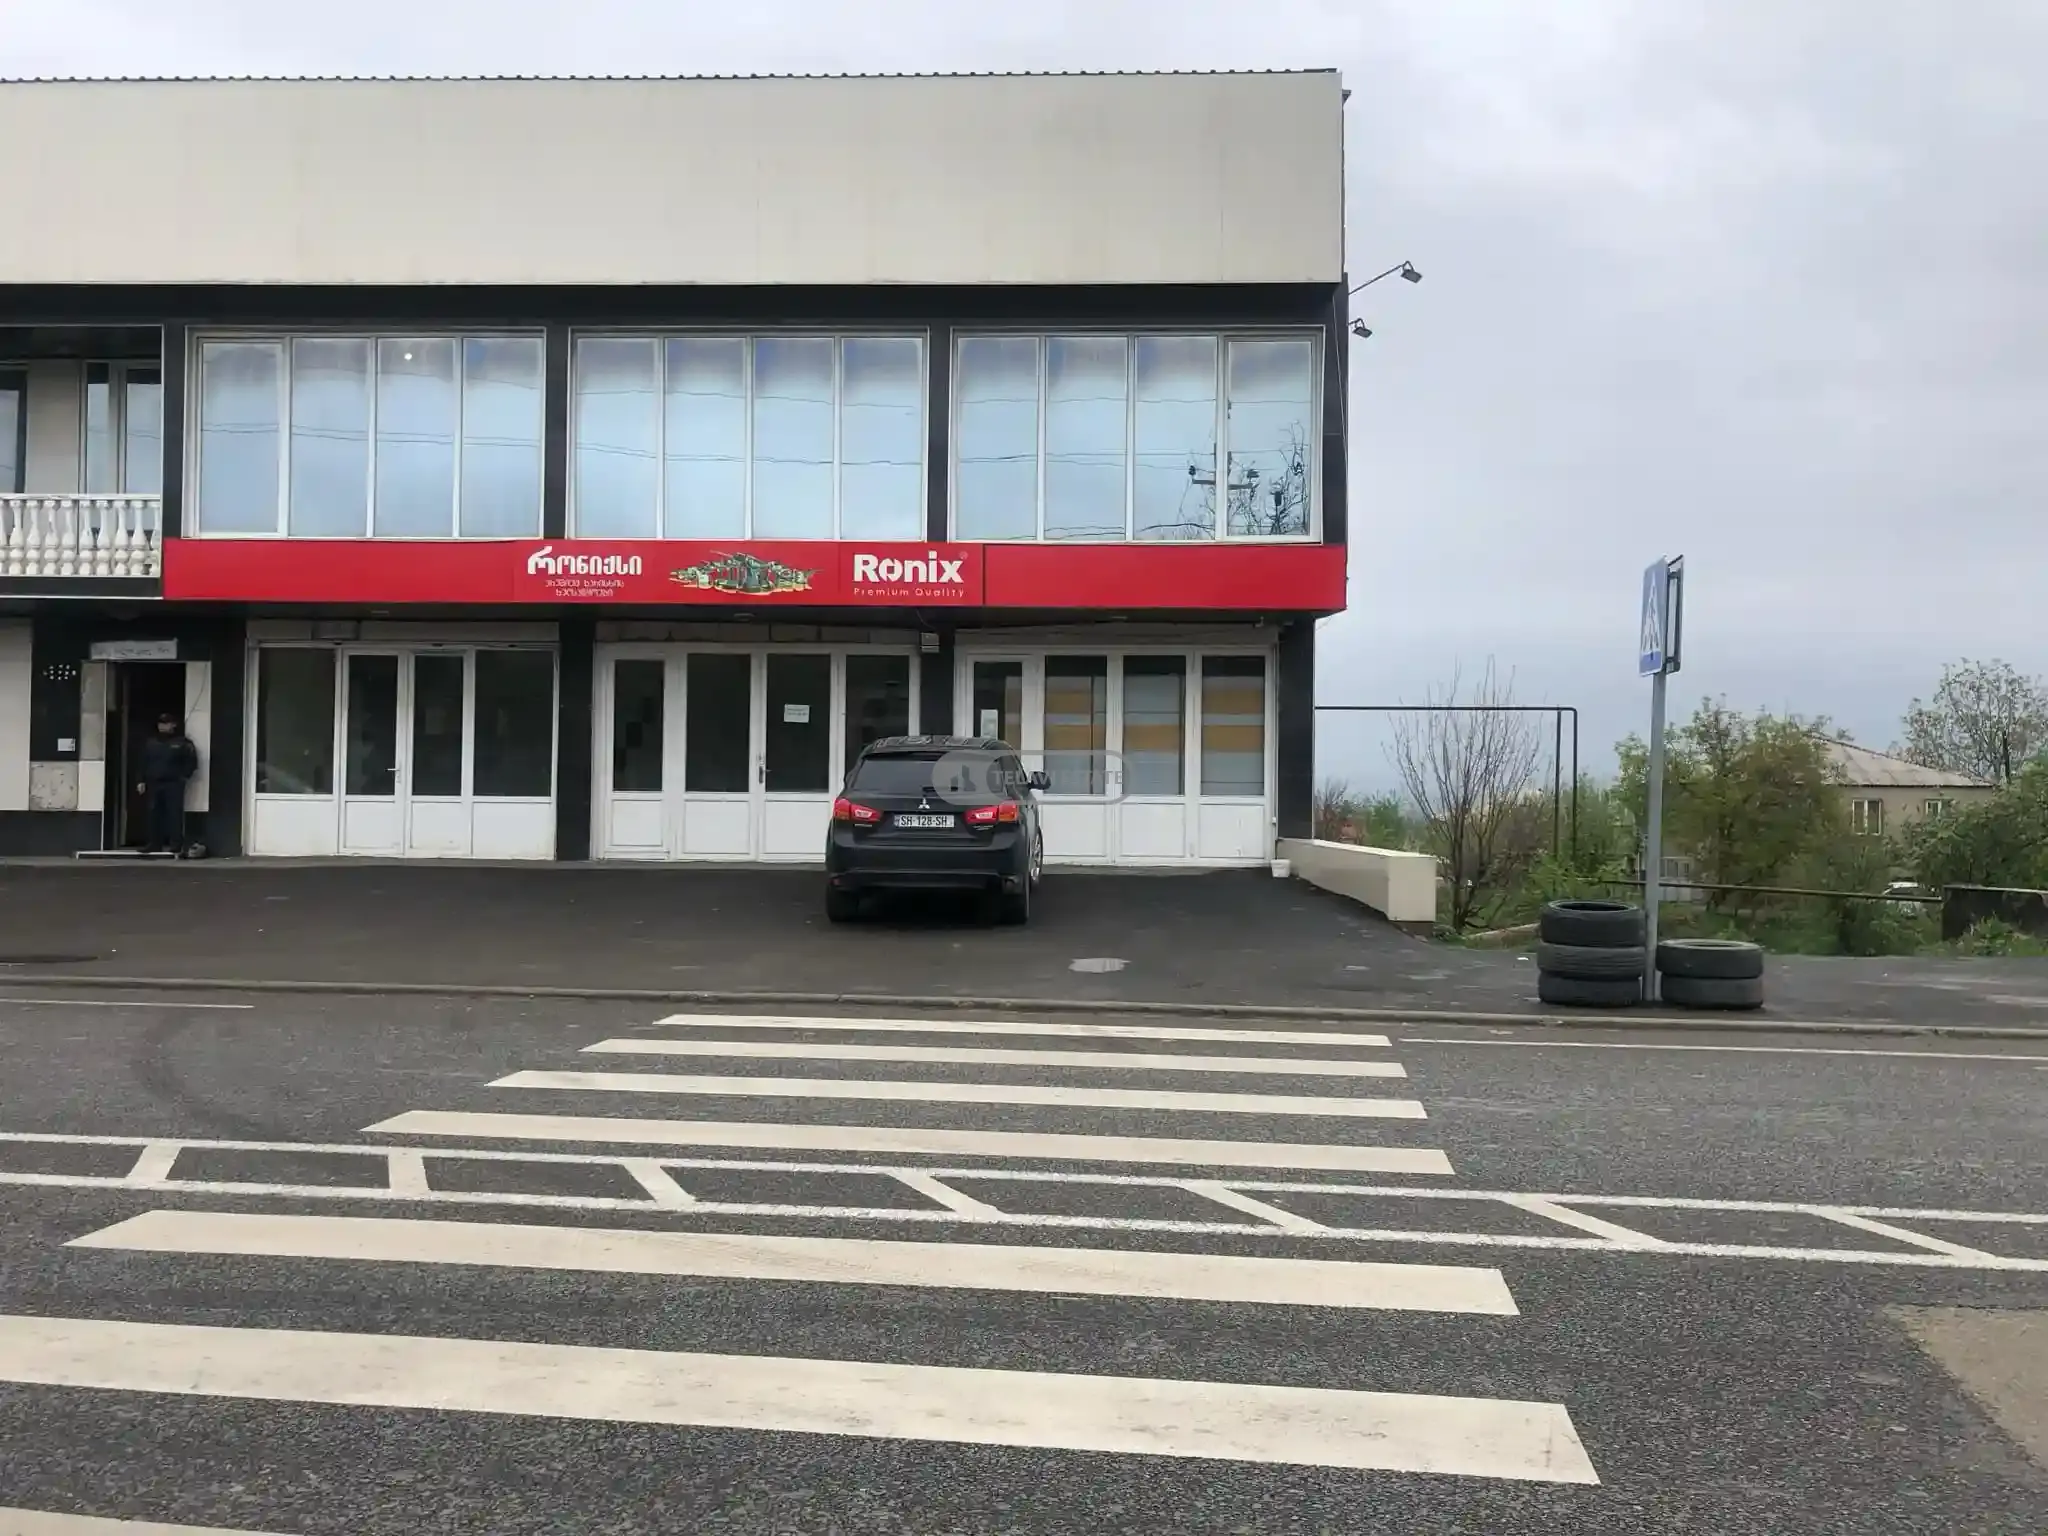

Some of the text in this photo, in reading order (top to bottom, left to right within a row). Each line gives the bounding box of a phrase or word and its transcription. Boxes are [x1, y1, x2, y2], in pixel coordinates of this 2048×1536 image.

[527, 545, 643, 575] რონიქსი
[853, 550, 964, 583] Ronix
[853, 587, 964, 598] Premium Quality
[900, 815, 947, 826] SH-128-SH
